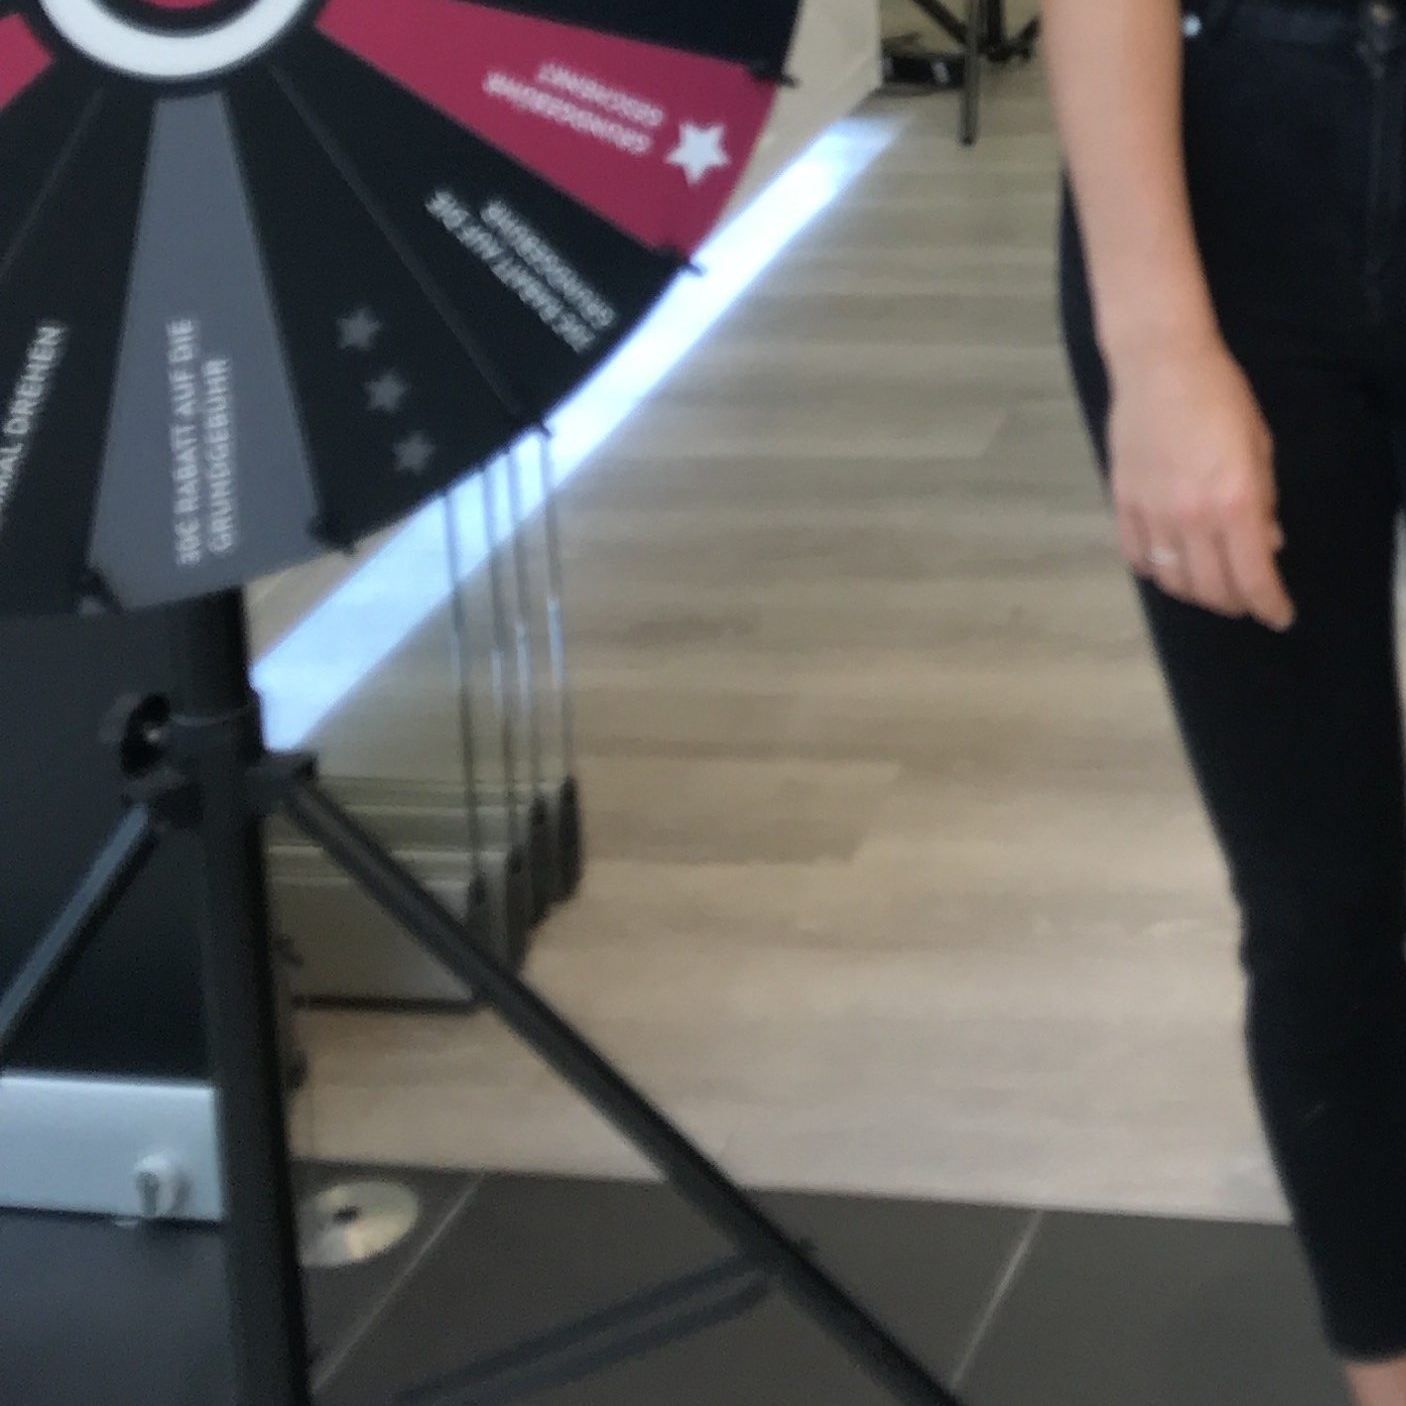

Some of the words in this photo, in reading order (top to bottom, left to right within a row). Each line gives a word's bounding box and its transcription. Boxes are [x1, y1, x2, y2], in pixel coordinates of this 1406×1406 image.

[167, 319, 195, 365] DIE
[3, 324, 63, 435] DREHEN
[169, 368, 200, 418] AUF
[170, 424, 201, 515] RABATT
